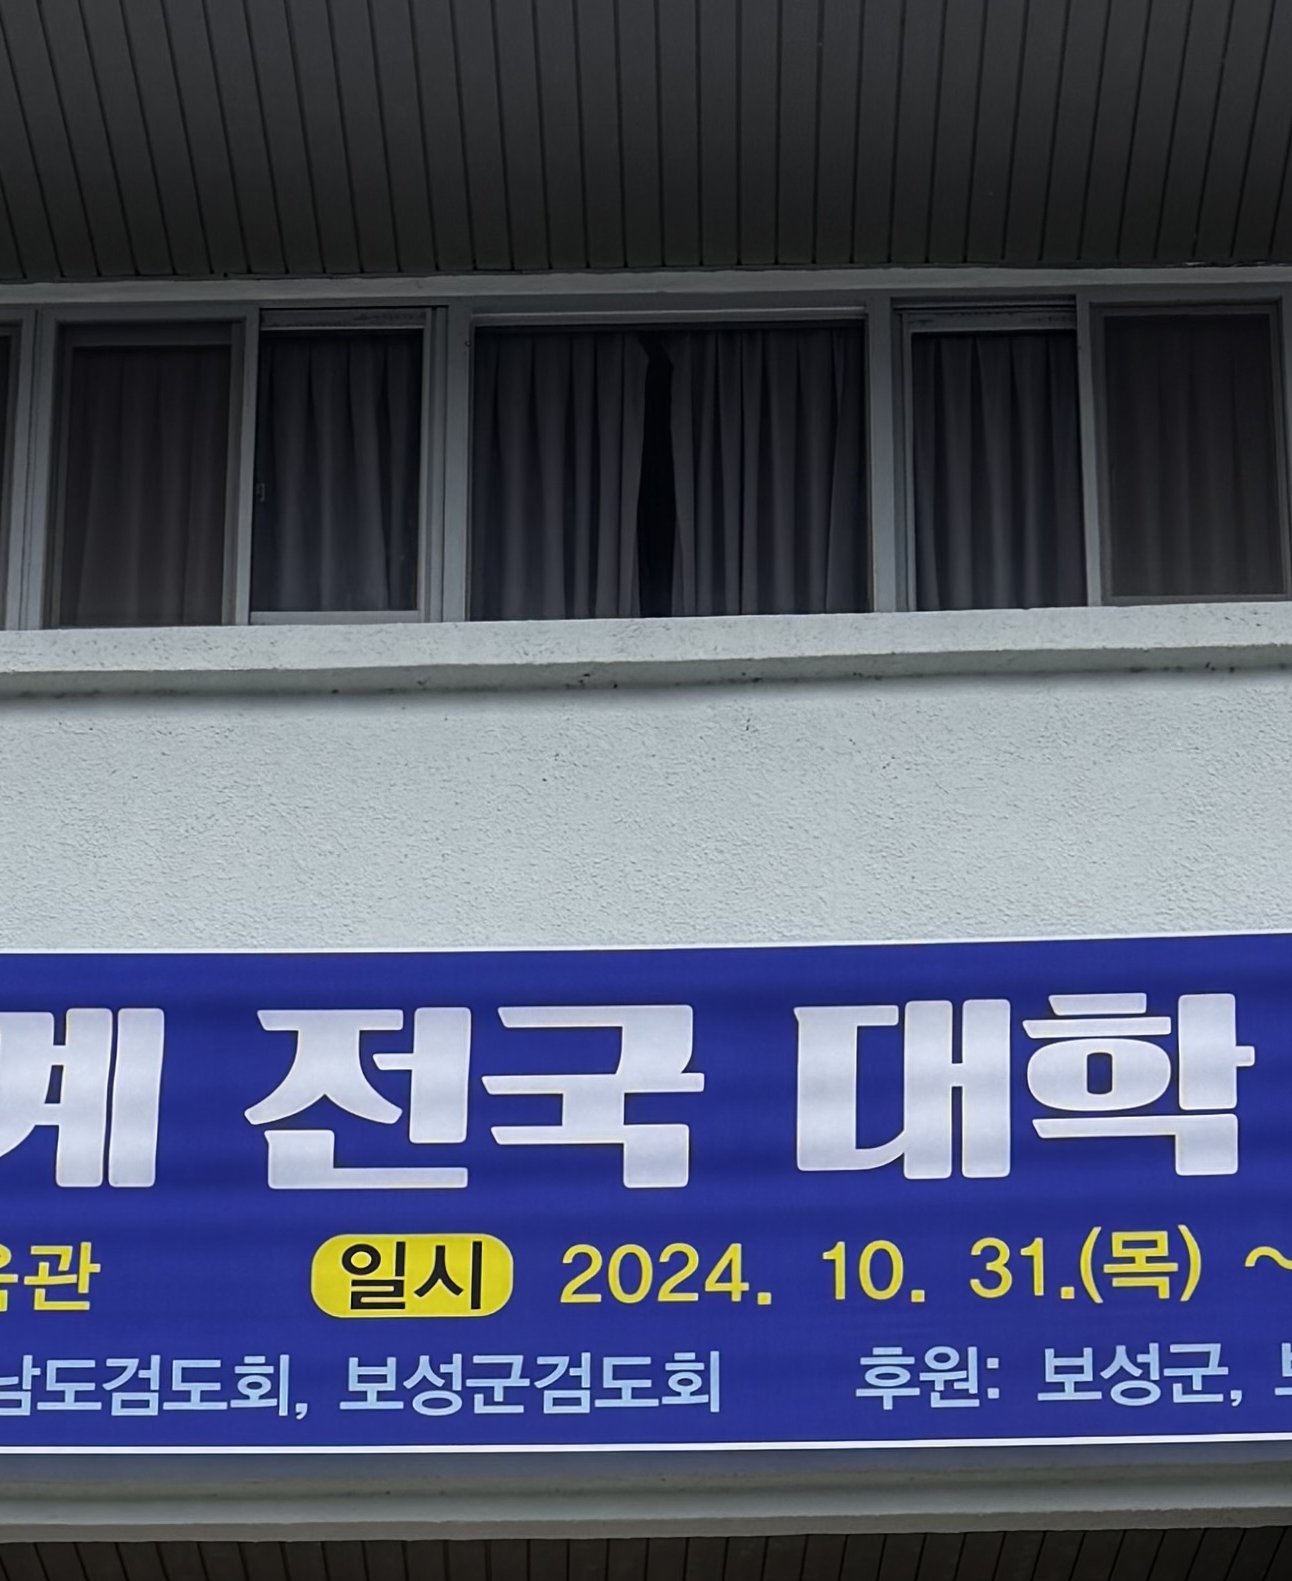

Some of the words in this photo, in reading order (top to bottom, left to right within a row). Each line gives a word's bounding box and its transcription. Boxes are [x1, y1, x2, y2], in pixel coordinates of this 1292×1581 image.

[244, 1004, 705, 1190] 전국
[793, 992, 1256, 1180] 대학
[341, 1240, 483, 1310] 일시
[559, 1242, 772, 1306] 2024.
[822, 1239, 926, 1303] 10.
[969, 1224, 1202, 1304] 31.(목)
[339, 1350, 720, 1417] 보성군검도회
[855, 1345, 1000, 1411] 후원:
[1037, 1342, 1243, 1407] 보성군,
